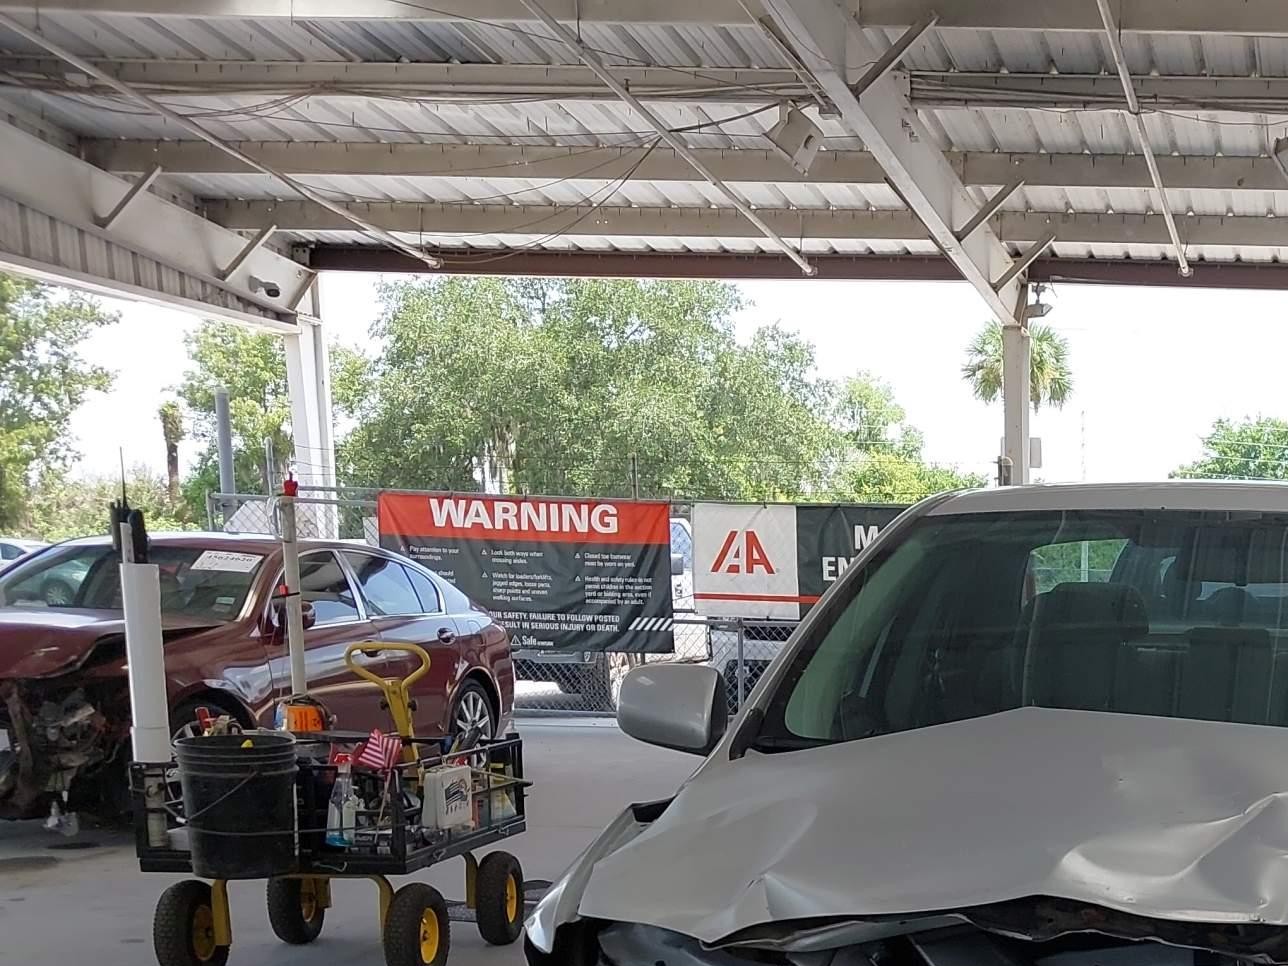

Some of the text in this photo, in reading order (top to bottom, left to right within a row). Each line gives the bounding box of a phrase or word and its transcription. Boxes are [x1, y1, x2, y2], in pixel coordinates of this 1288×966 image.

[429, 498, 618, 533] WARNING
[409, 545, 419, 553] Pay
[556, 613, 565, 621] TO
[566, 614, 594, 622] FOLLOW
[594, 615, 620, 623] POSTED
[521, 621, 530, 629] IN
[531, 622, 559, 630] SERIOUS
[560, 623, 584, 631] INJURY
[596, 624, 620, 632] DEATH.
[522, 635, 537, 645] Safe
